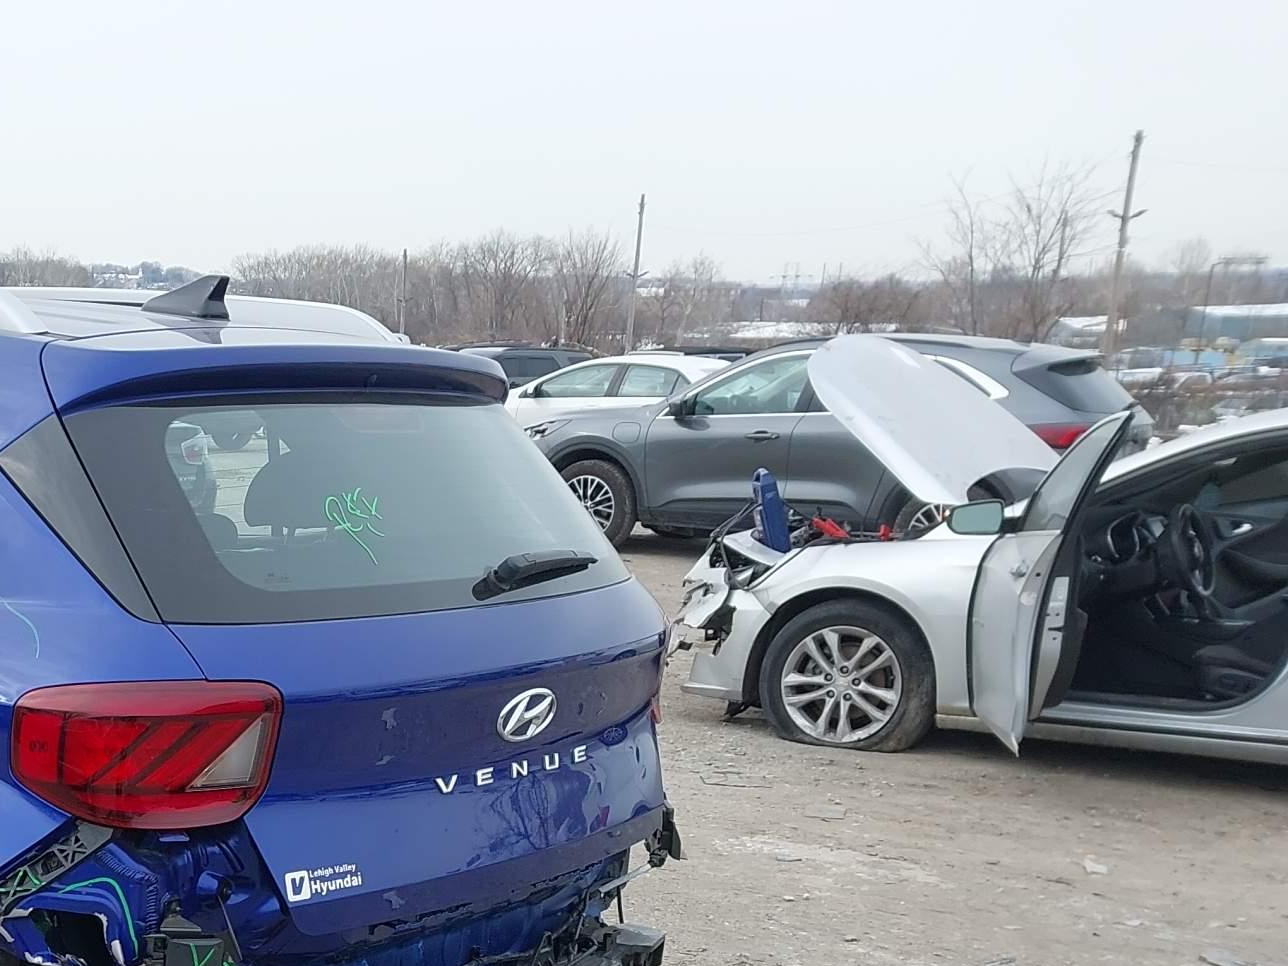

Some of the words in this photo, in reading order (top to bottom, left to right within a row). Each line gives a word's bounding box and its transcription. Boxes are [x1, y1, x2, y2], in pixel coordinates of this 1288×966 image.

[434, 744, 588, 794] VENUE
[309, 867, 334, 878] Lehigh
[334, 863, 356, 874] Valley
[310, 872, 362, 896] Hyundai
